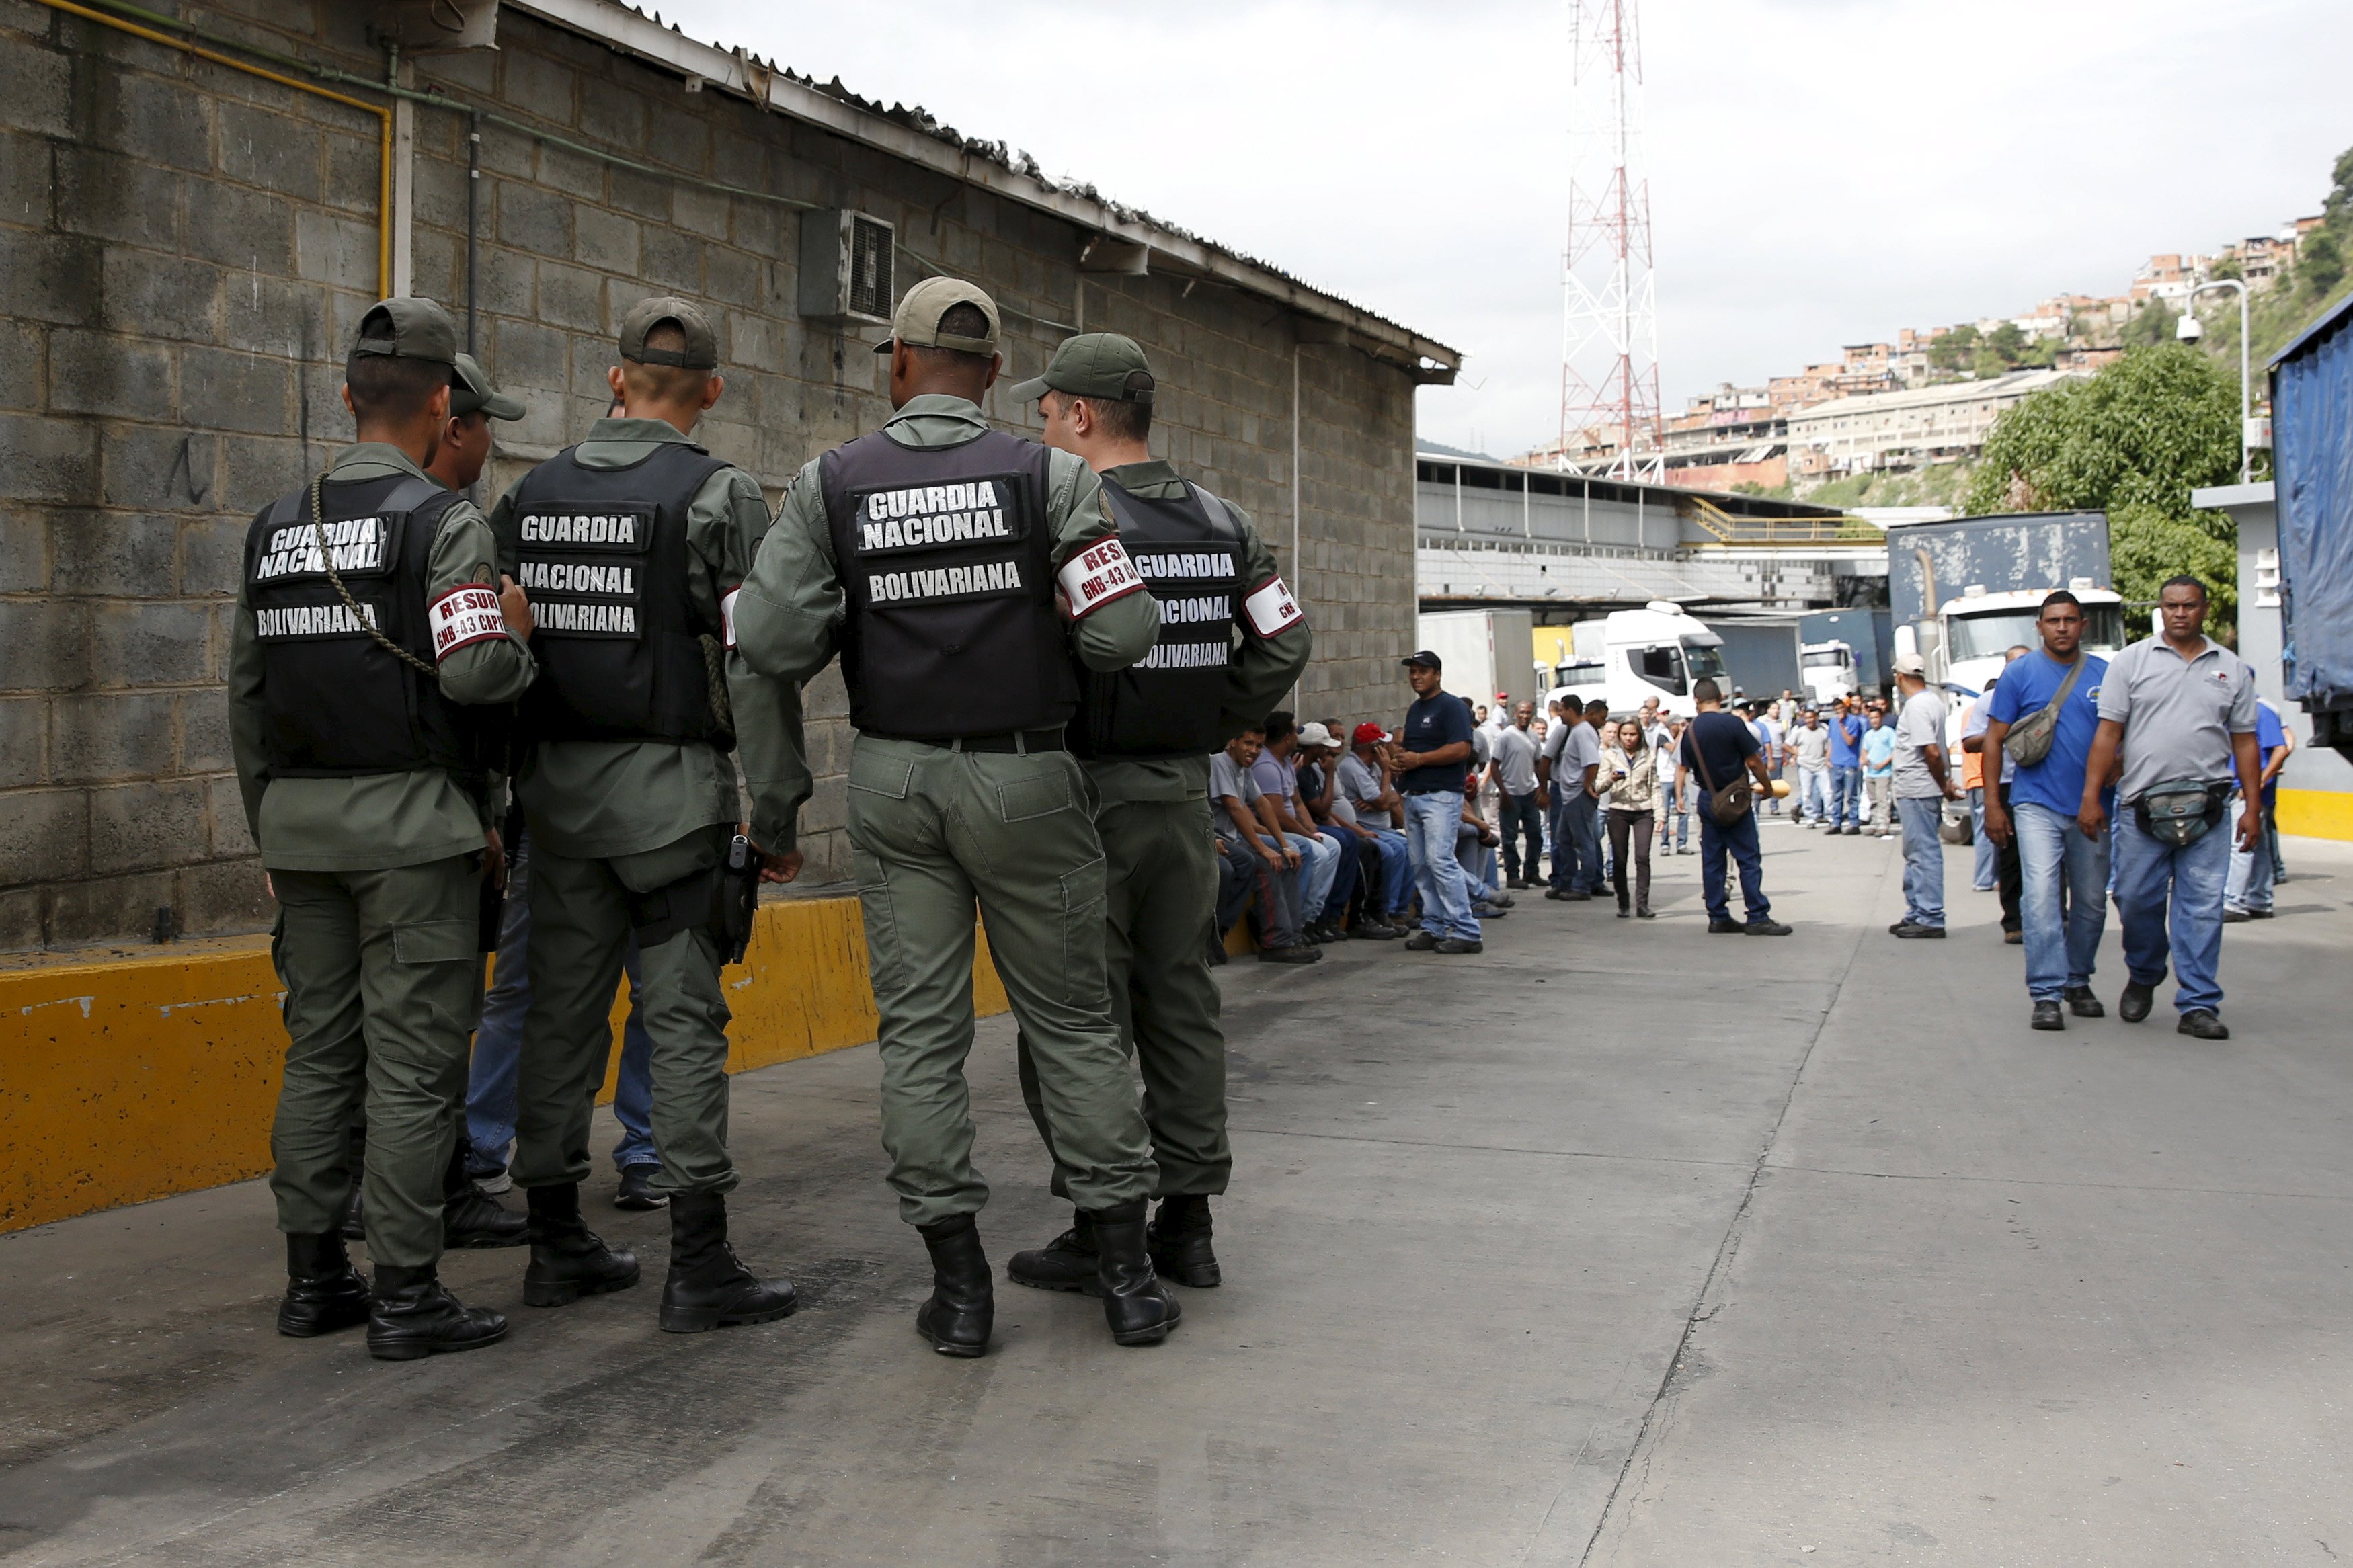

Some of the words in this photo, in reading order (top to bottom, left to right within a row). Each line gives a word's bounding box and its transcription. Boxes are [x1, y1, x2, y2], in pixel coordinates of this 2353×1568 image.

[868, 481, 998, 520] GUARDIA
[270, 517, 376, 554] GUARDIA
[520, 515, 635, 544] GUARDIA
[863, 509, 1009, 550] NACIONAL
[257, 544, 378, 579] NACIONAL
[1135, 553, 1236, 578] GUARDIA
[519, 562, 635, 594] NACIONAL
[869, 561, 1021, 602] BOLIVARIANA
[1081, 565, 1125, 601] GNB-43
[257, 604, 378, 636] BOLIVARIANA
[440, 593, 499, 621] RESUR
[529, 602, 635, 632] OLIVARIANA
[1158, 595, 1232, 624] ACIONAL
[436, 616, 476, 649] GNB-43
[478, 614, 504, 632] CAPI
[1132, 641, 1228, 669] OLIVARIANA
